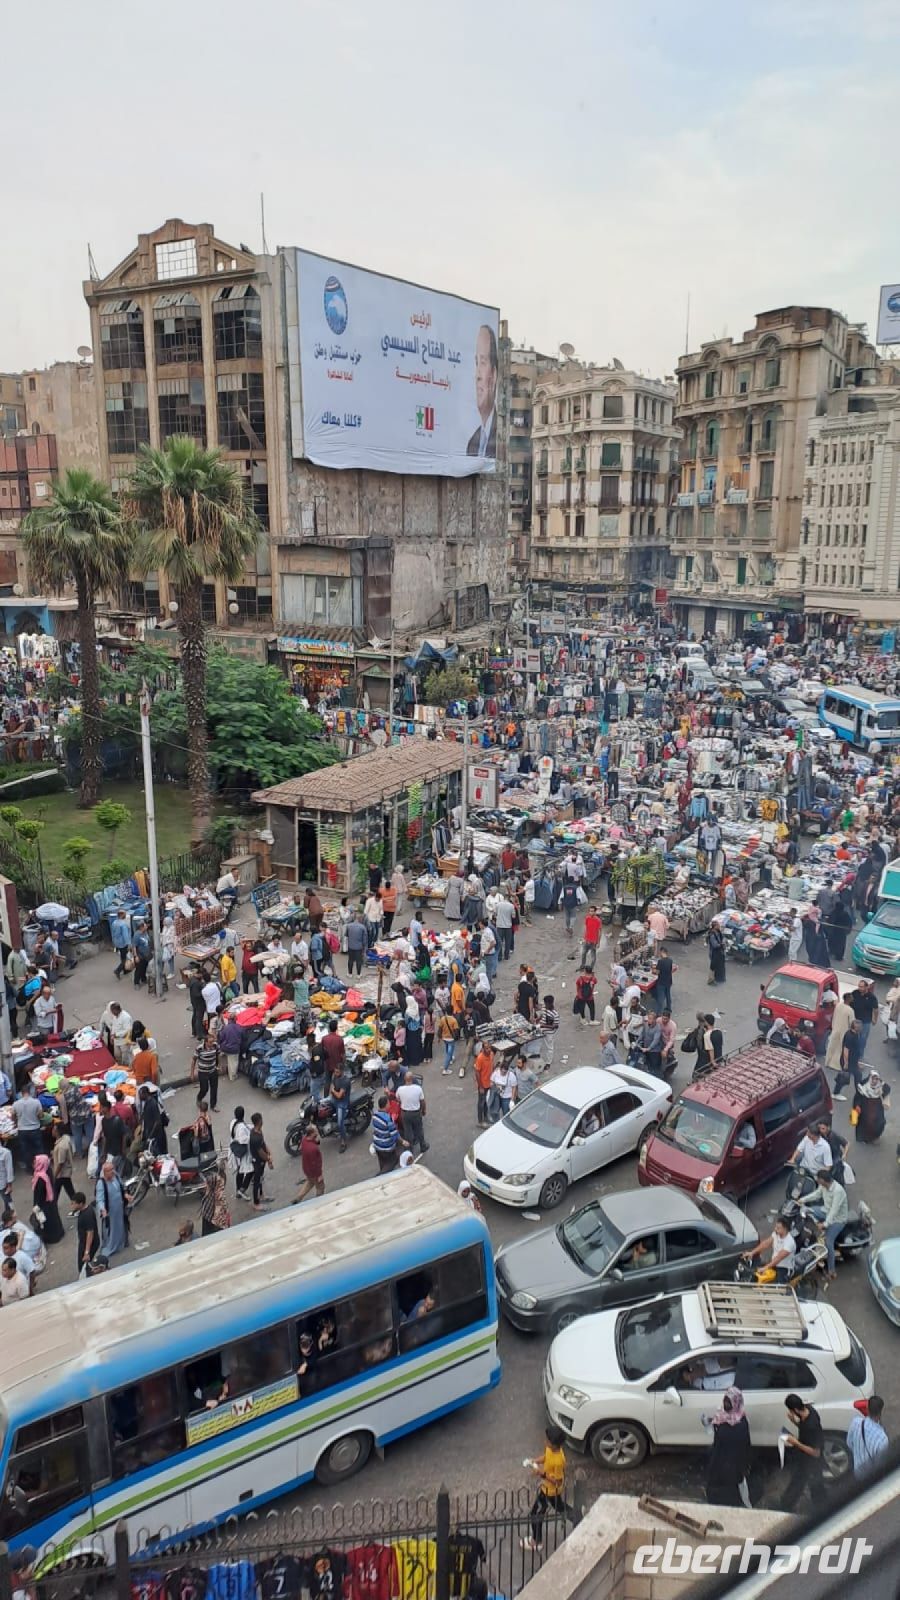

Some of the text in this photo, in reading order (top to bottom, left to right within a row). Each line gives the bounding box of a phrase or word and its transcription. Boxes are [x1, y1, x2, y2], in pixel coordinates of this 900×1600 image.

[380, 335, 461, 368] عبد الفتاح السيسي
[274, 1575, 285, 1593] 7
